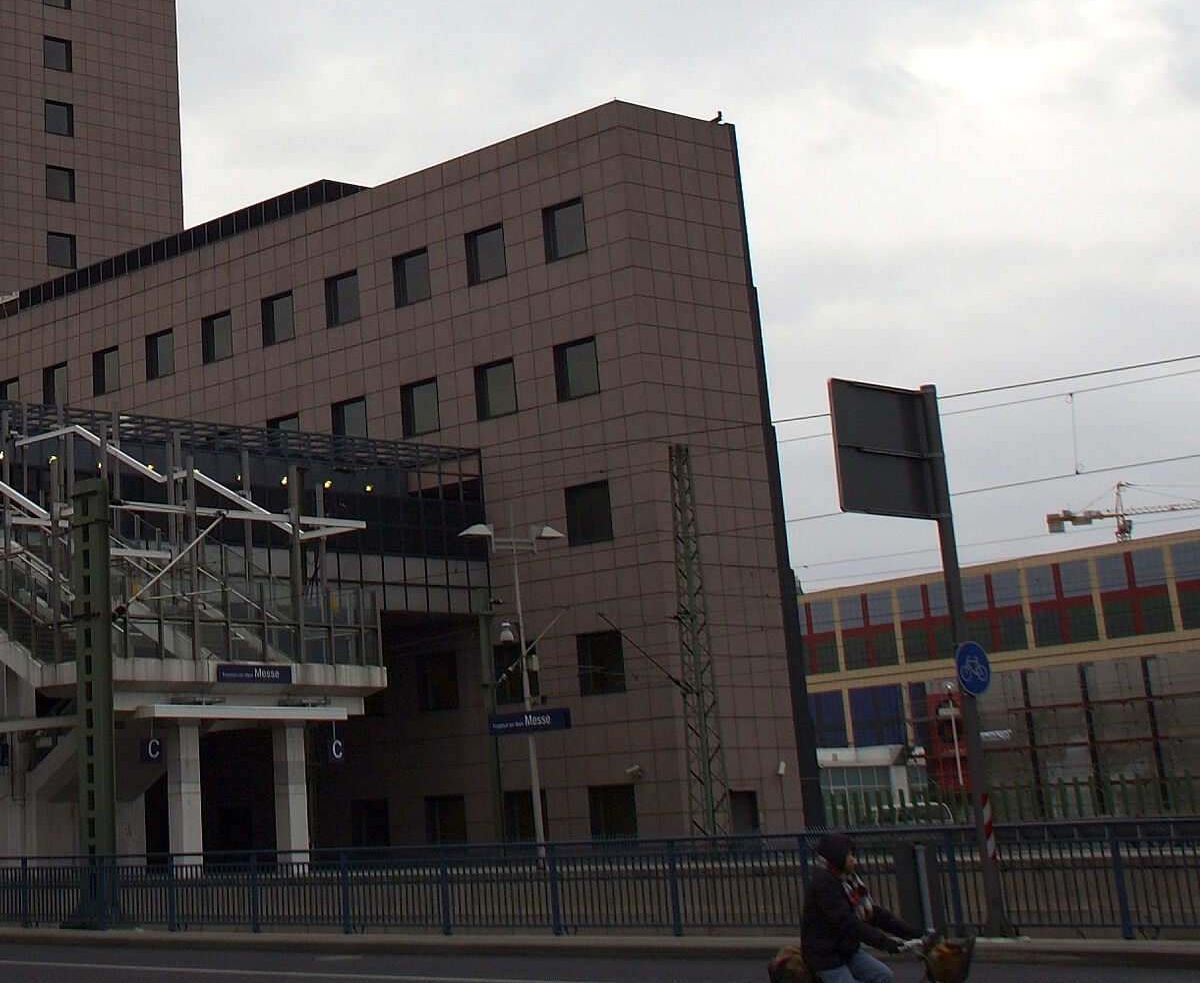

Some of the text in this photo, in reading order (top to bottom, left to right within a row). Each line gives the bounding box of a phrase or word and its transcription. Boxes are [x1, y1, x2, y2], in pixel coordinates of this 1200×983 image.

[254, 667, 280, 678] Messe
[524, 713, 551, 727] Messe
[148, 738, 161, 758] C
[332, 739, 343, 759] C
